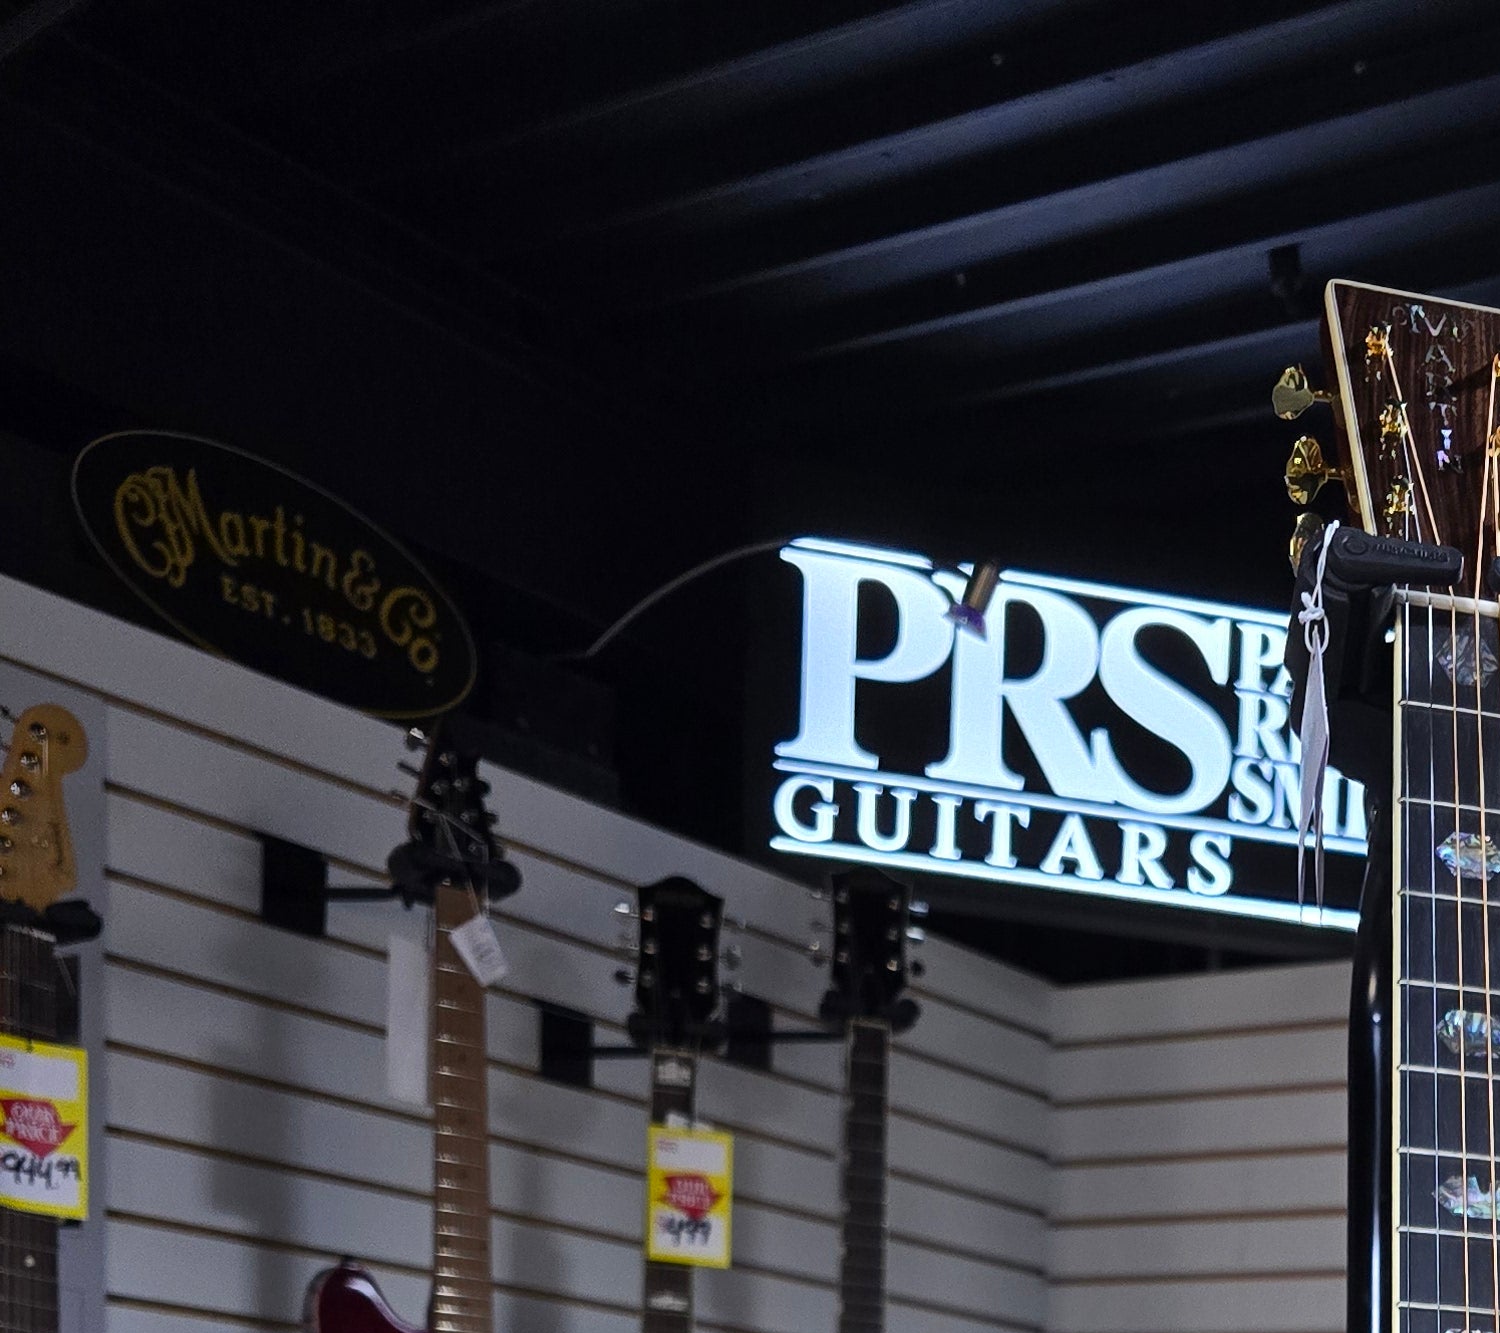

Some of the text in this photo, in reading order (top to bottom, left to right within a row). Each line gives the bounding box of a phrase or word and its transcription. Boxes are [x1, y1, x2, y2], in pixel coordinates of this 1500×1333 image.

[302, 607, 378, 660] 1833
[775, 546, 1233, 815] PRS
[774, 777, 1233, 896] GUITARS
